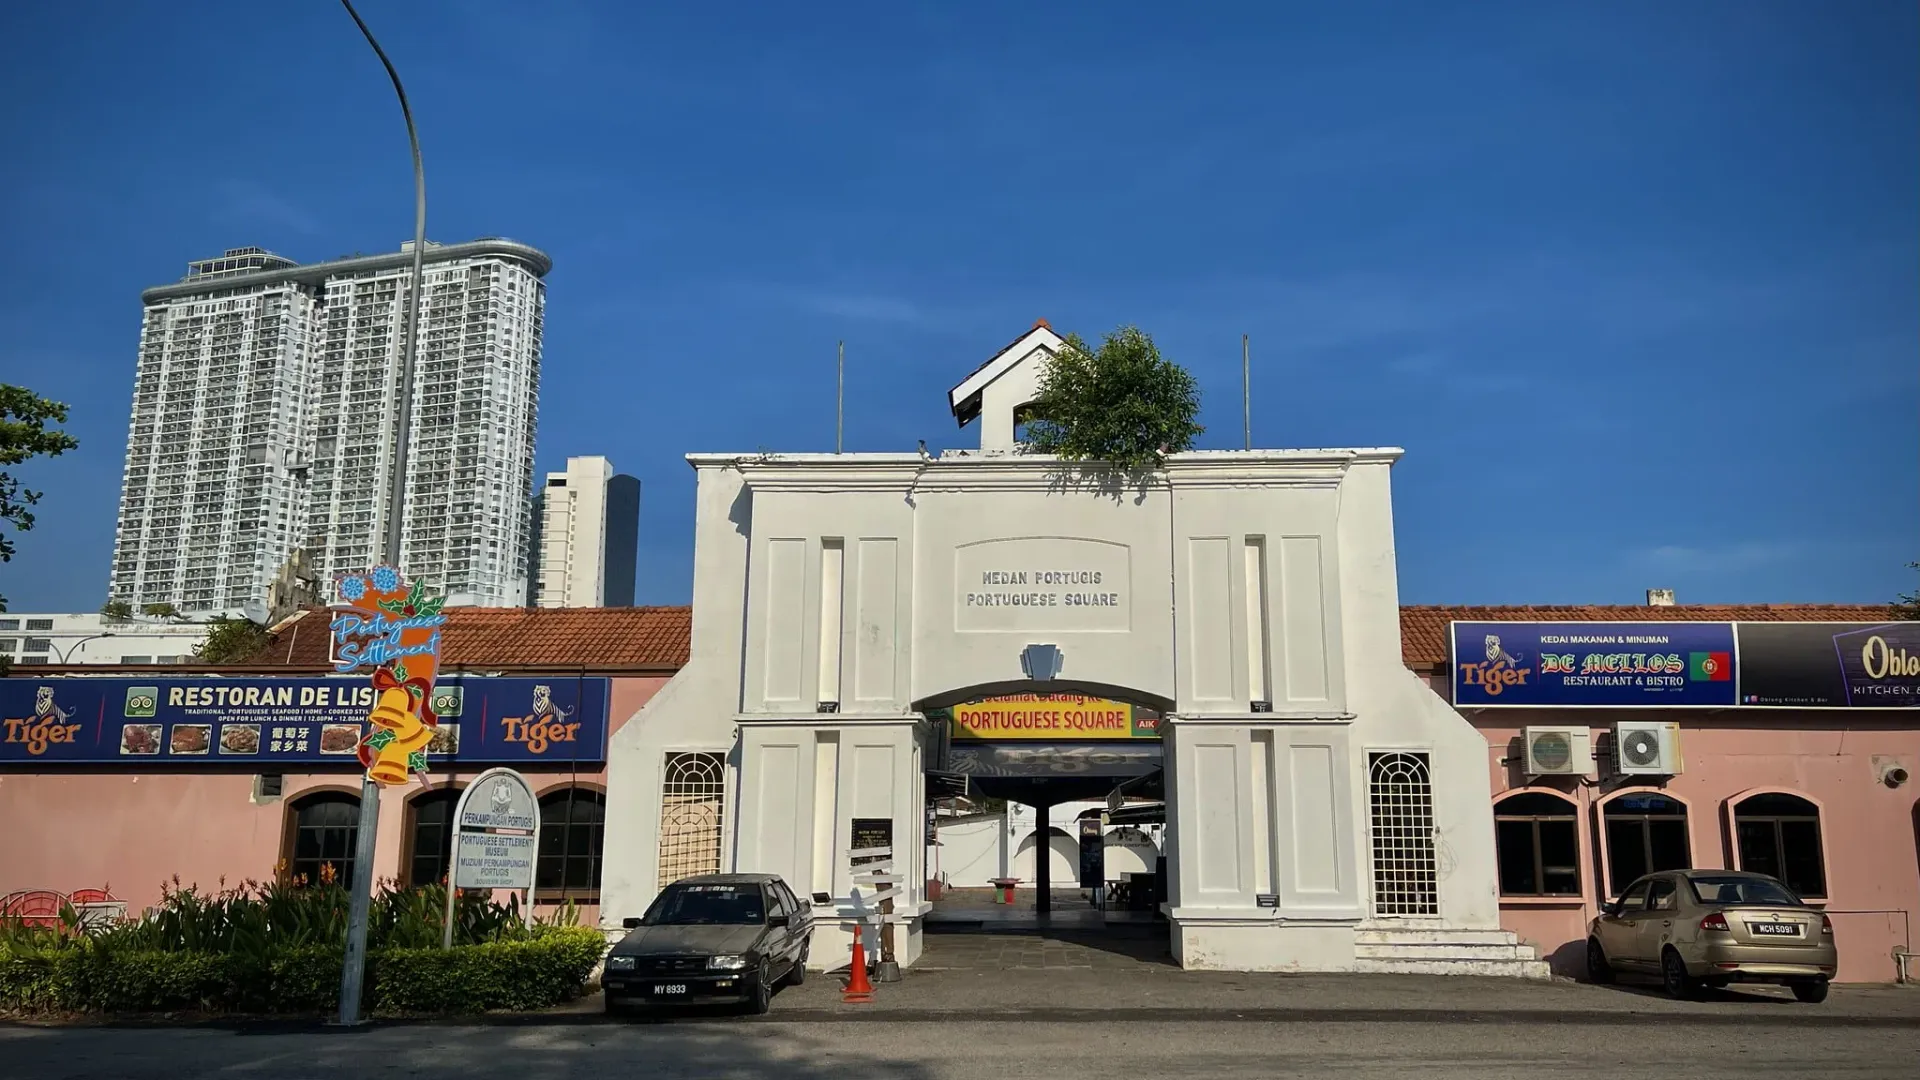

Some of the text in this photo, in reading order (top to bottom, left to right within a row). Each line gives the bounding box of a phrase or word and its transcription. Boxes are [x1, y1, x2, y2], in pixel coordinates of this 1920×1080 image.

[983, 571, 1102, 585] MEDAN PORTUGIS
[966, 593, 1119, 607] PORTUGUESE SQUARE
[329, 612, 447, 645] Portuguese
[1541, 635, 1669, 644] KEDAI MAKANAN & MINUMAN
[335, 631, 440, 671] Settlement
[1540, 652, 1685, 675] DE MELLOS
[1460, 660, 1531, 696] Tiger
[1563, 676, 1684, 686] RESTAURANT & BISTRO
[168, 686, 373, 706] RESTORAN DE LIS
[1853, 686, 1910, 695] KITCHEN
[1038, 692, 1084, 706] atang
[960, 711, 1125, 730] PORTUGUESE SQUARE
[3, 715, 82, 755] Tiger
[272, 727, 310, 739] 葡萄牙
[501, 714, 581, 754] Tiger
[270, 740, 308, 752] 家乡菜
[464, 812, 533, 828] PERKAMPUNGAN PORTUGIS
[461, 834, 533, 848] PORTUGUESE SETTLEMENT
[485, 847, 509, 857] MUSEUM
[460, 857, 530, 869] MUZIUM PERKAMPUNGAN
[480, 868, 510, 877] PORTUGIS
[1776, 925, 1793, 934] 5091
[654, 984, 686, 994] MY 8933
